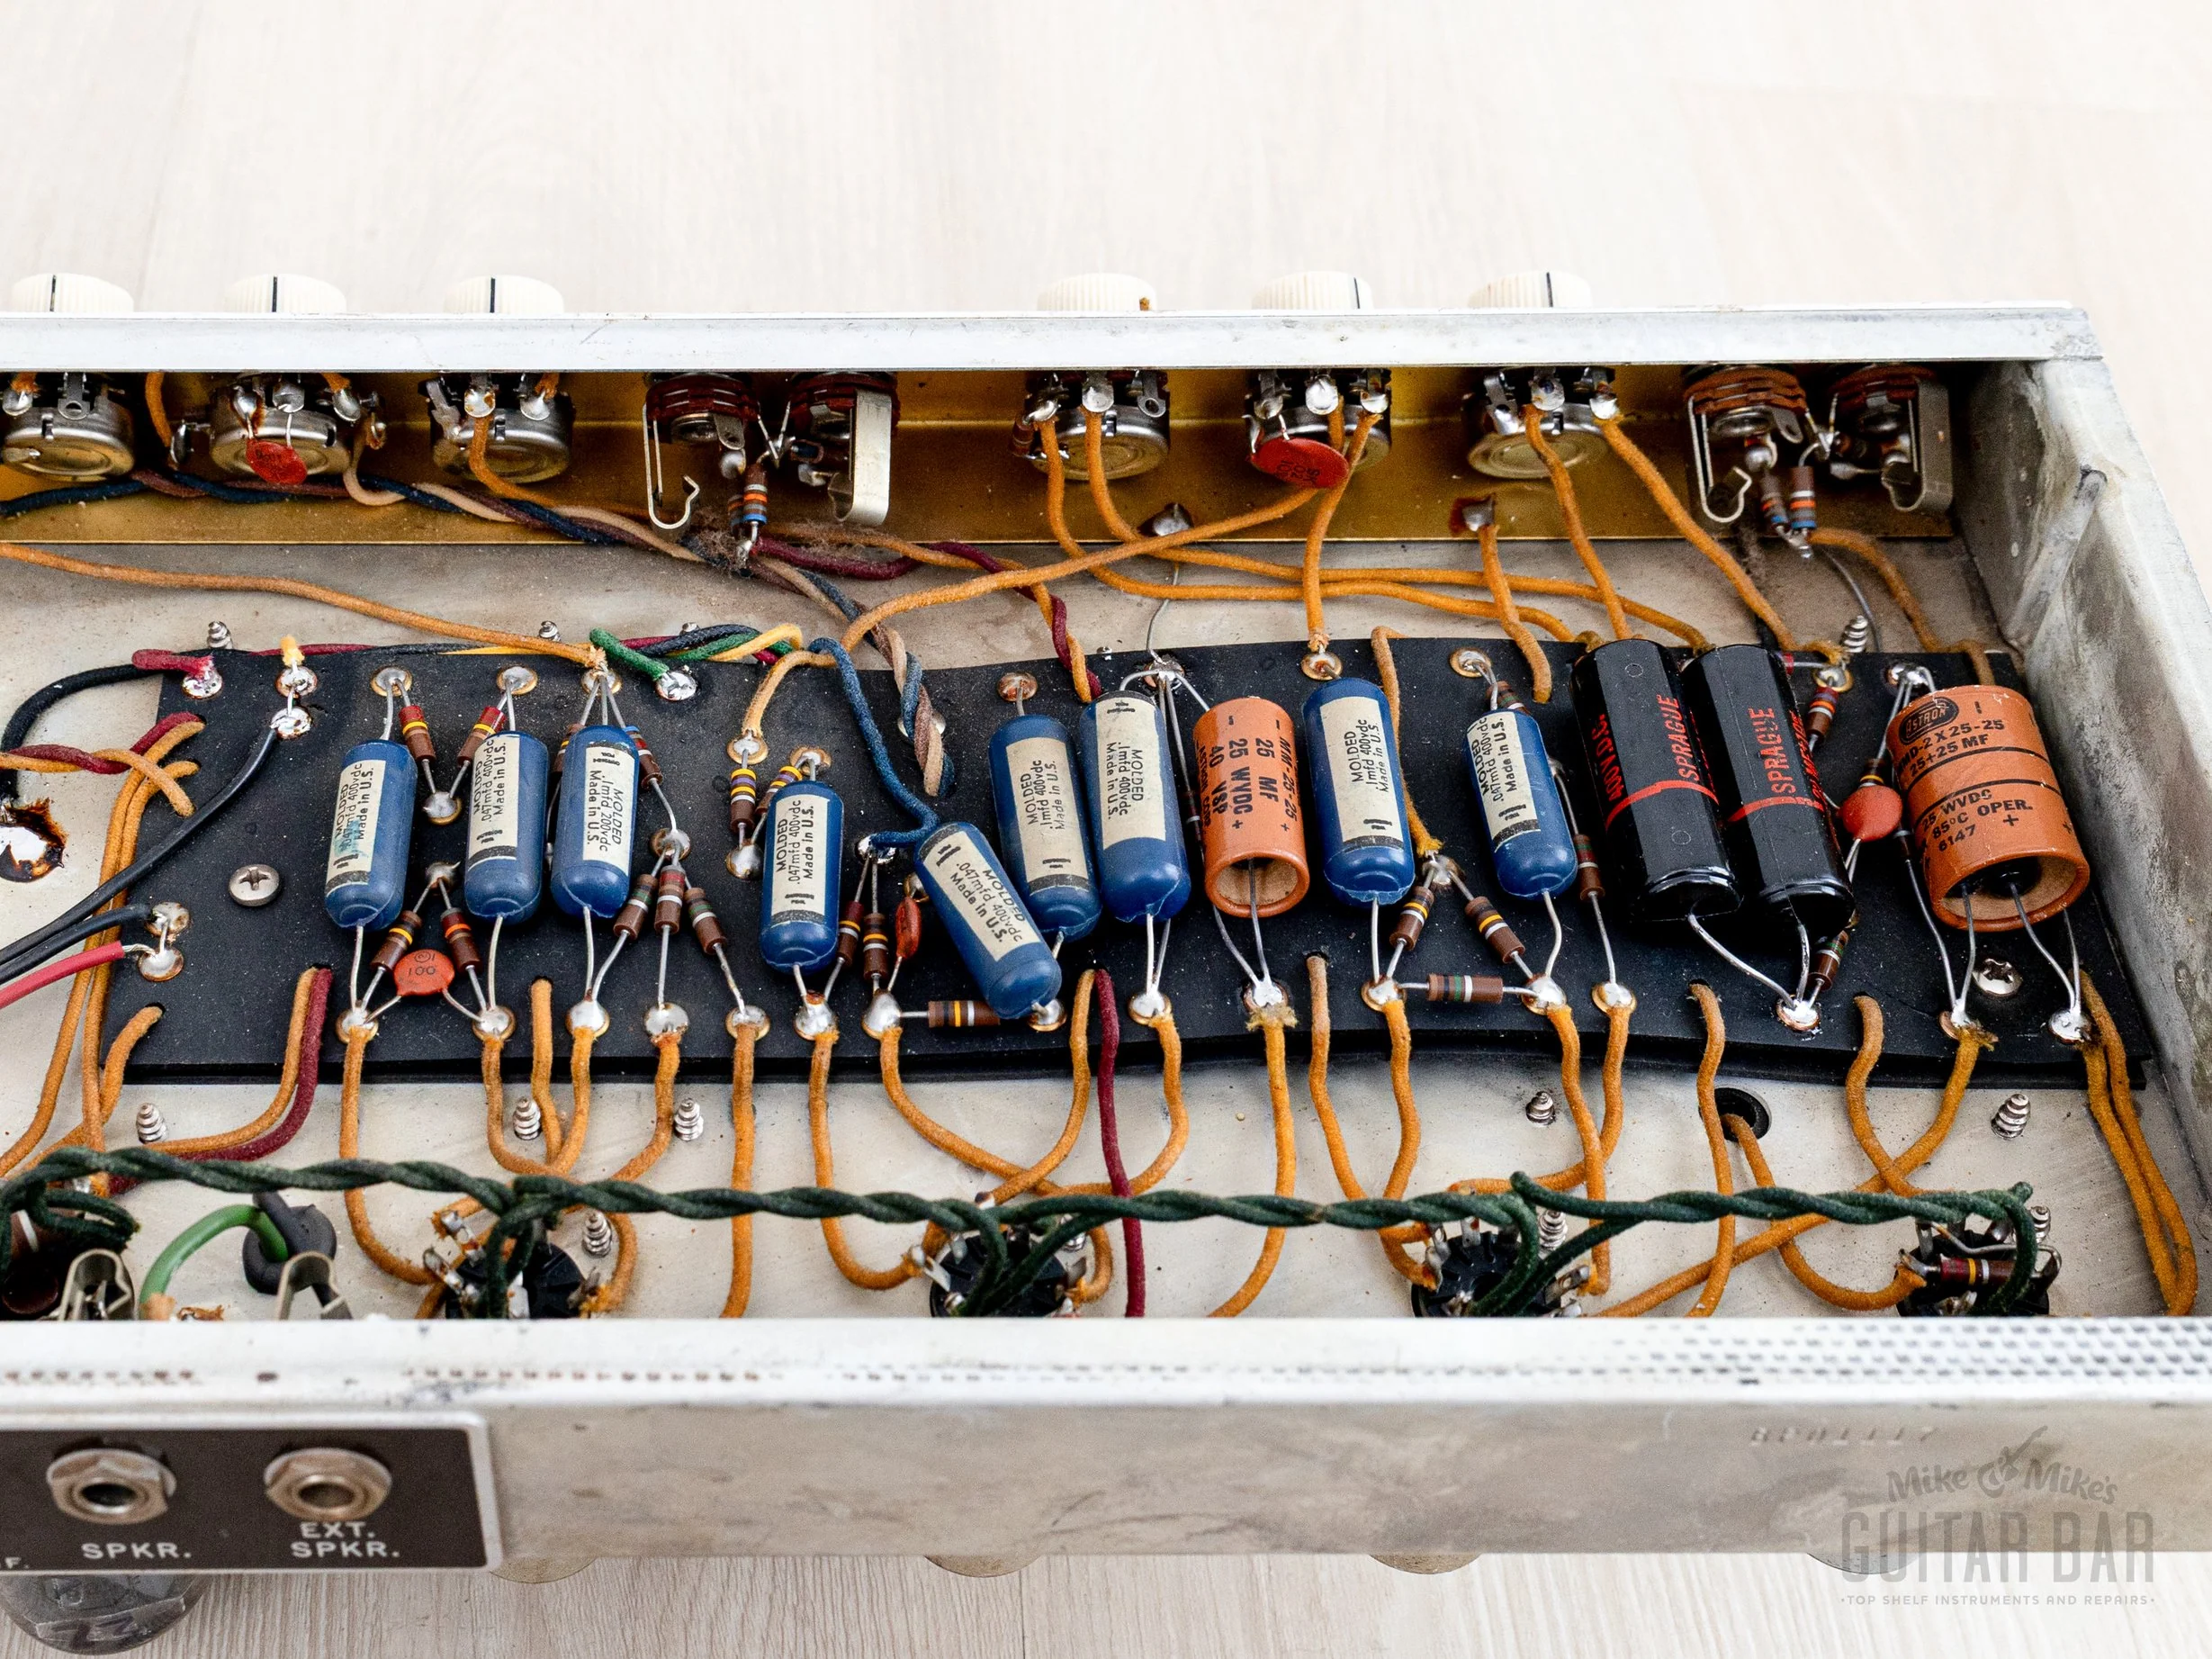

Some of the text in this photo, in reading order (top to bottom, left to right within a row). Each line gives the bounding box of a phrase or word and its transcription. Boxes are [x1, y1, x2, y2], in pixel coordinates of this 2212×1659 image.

[1229, 738, 1249, 759] 25
[1477, 717, 1492, 755] 400vdc
[1498, 744, 1509, 756] in
[1656, 694, 1700, 782] SPRAGUE
[1950, 719, 2005, 738] 25-25
[1255, 738, 1279, 803] 25 MF
[1344, 731, 1364, 782] MOLDED
[1373, 747, 1382, 757] in
[1471, 739, 1489, 796] MOLDED
[1748, 708, 1797, 795] SPRAGUE
[1911, 734, 1989, 777] 25+25 MF
[473, 761, 483, 815] MOLDED
[493, 769, 505, 780] in
[1030, 760, 1045, 796] 400vdc
[1044, 761, 1066, 830] Made in U.S.
[1106, 742, 1119, 820] Made in U.S.
[1119, 776, 1131, 816] 400vdc
[1131, 749, 1144, 801] MOLDED
[1209, 745, 1228, 815] 40 VSP
[1231, 766, 1253, 815] WVDC
[1279, 737, 1298, 821] MM-25-25
[1378, 761, 1389, 792] Made
[1502, 760, 1516, 792] Made
[334, 783, 349, 839] MOLDED
[357, 793, 370, 804] in
[493, 782, 505, 815] Made
[587, 770, 602, 845] Made in U.S.
[611, 788, 624, 845] MOLDED
[788, 799, 801, 838] 400vdc
[1021, 773, 1039, 825] MOLDED
[1922, 789, 1992, 834] 25 WVDC
[1977, 799, 2033, 816] OPER.
[355, 807, 368, 840] Made
[599, 812, 612, 852] 200vdc
[776, 818, 787, 872] MOLDED
[801, 806, 814, 879] Made in U.S.
[1938, 825, 1976, 852] 6147
[949, 871, 977, 906] Made
[975, 902, 988, 918] in
[982, 869, 1026, 922] MOLDED
[992, 904, 1023, 942] 400vdc
[81, 1542, 192, 1560] SPKR.
[291, 1541, 400, 1558] SPKR.
[300, 1522, 375, 1539] EXT.
